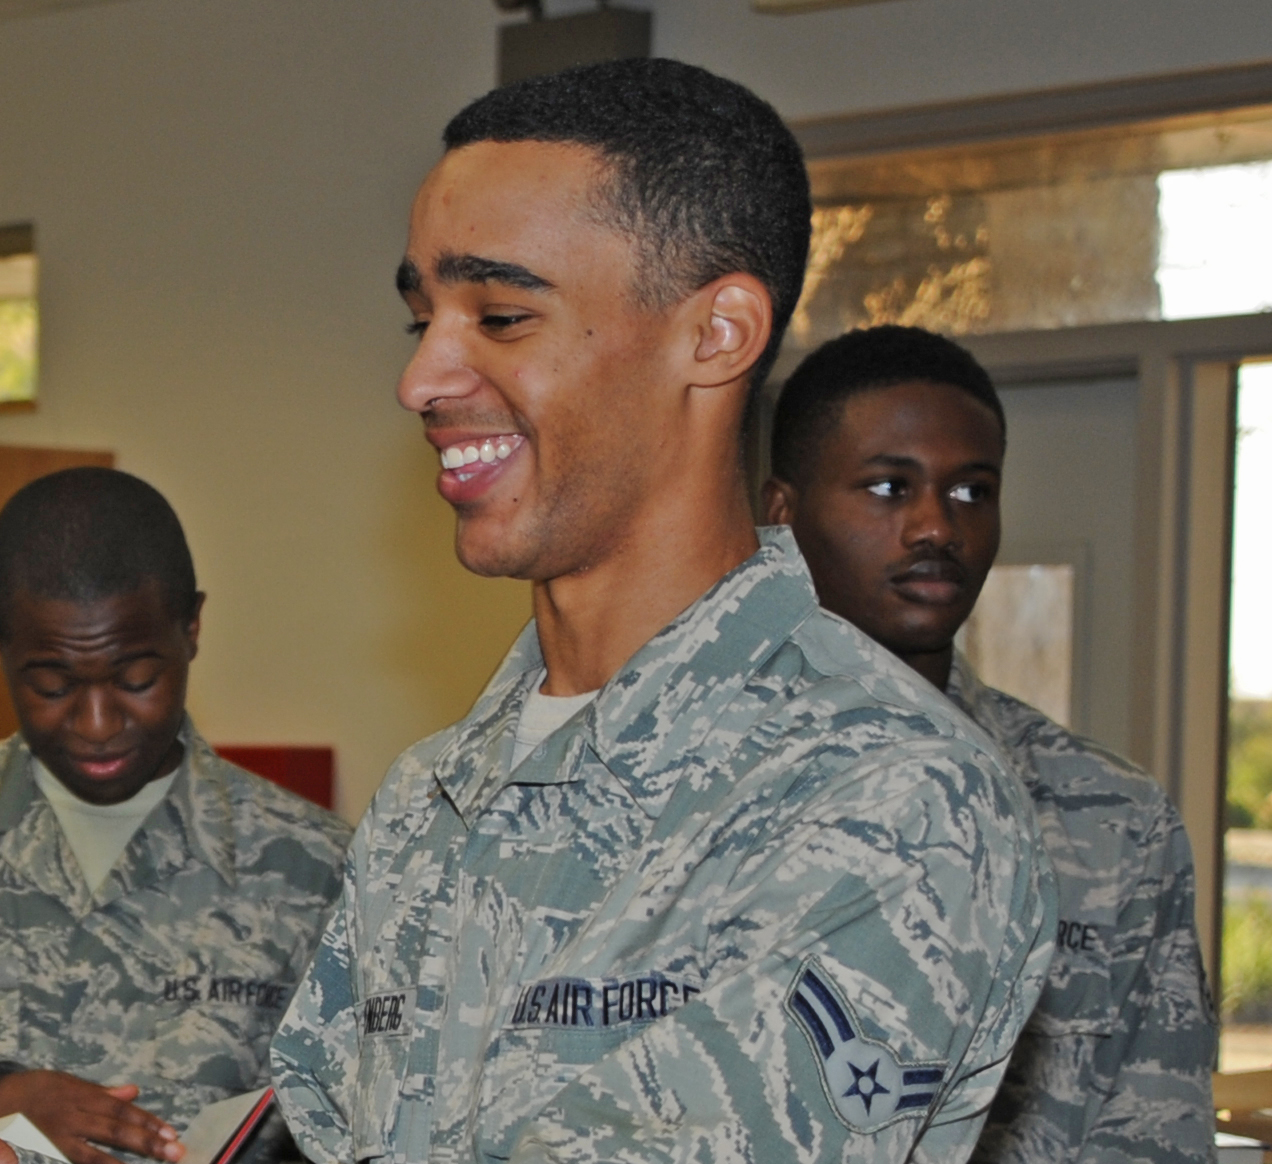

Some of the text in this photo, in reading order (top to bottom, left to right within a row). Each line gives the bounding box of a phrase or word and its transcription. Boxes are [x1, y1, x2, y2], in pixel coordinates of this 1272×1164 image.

[1057, 919, 1097, 952] RCE
[208, 977, 243, 1003] AIR
[511, 985, 542, 1025] U.S.
[546, 983, 594, 1026] AIR
